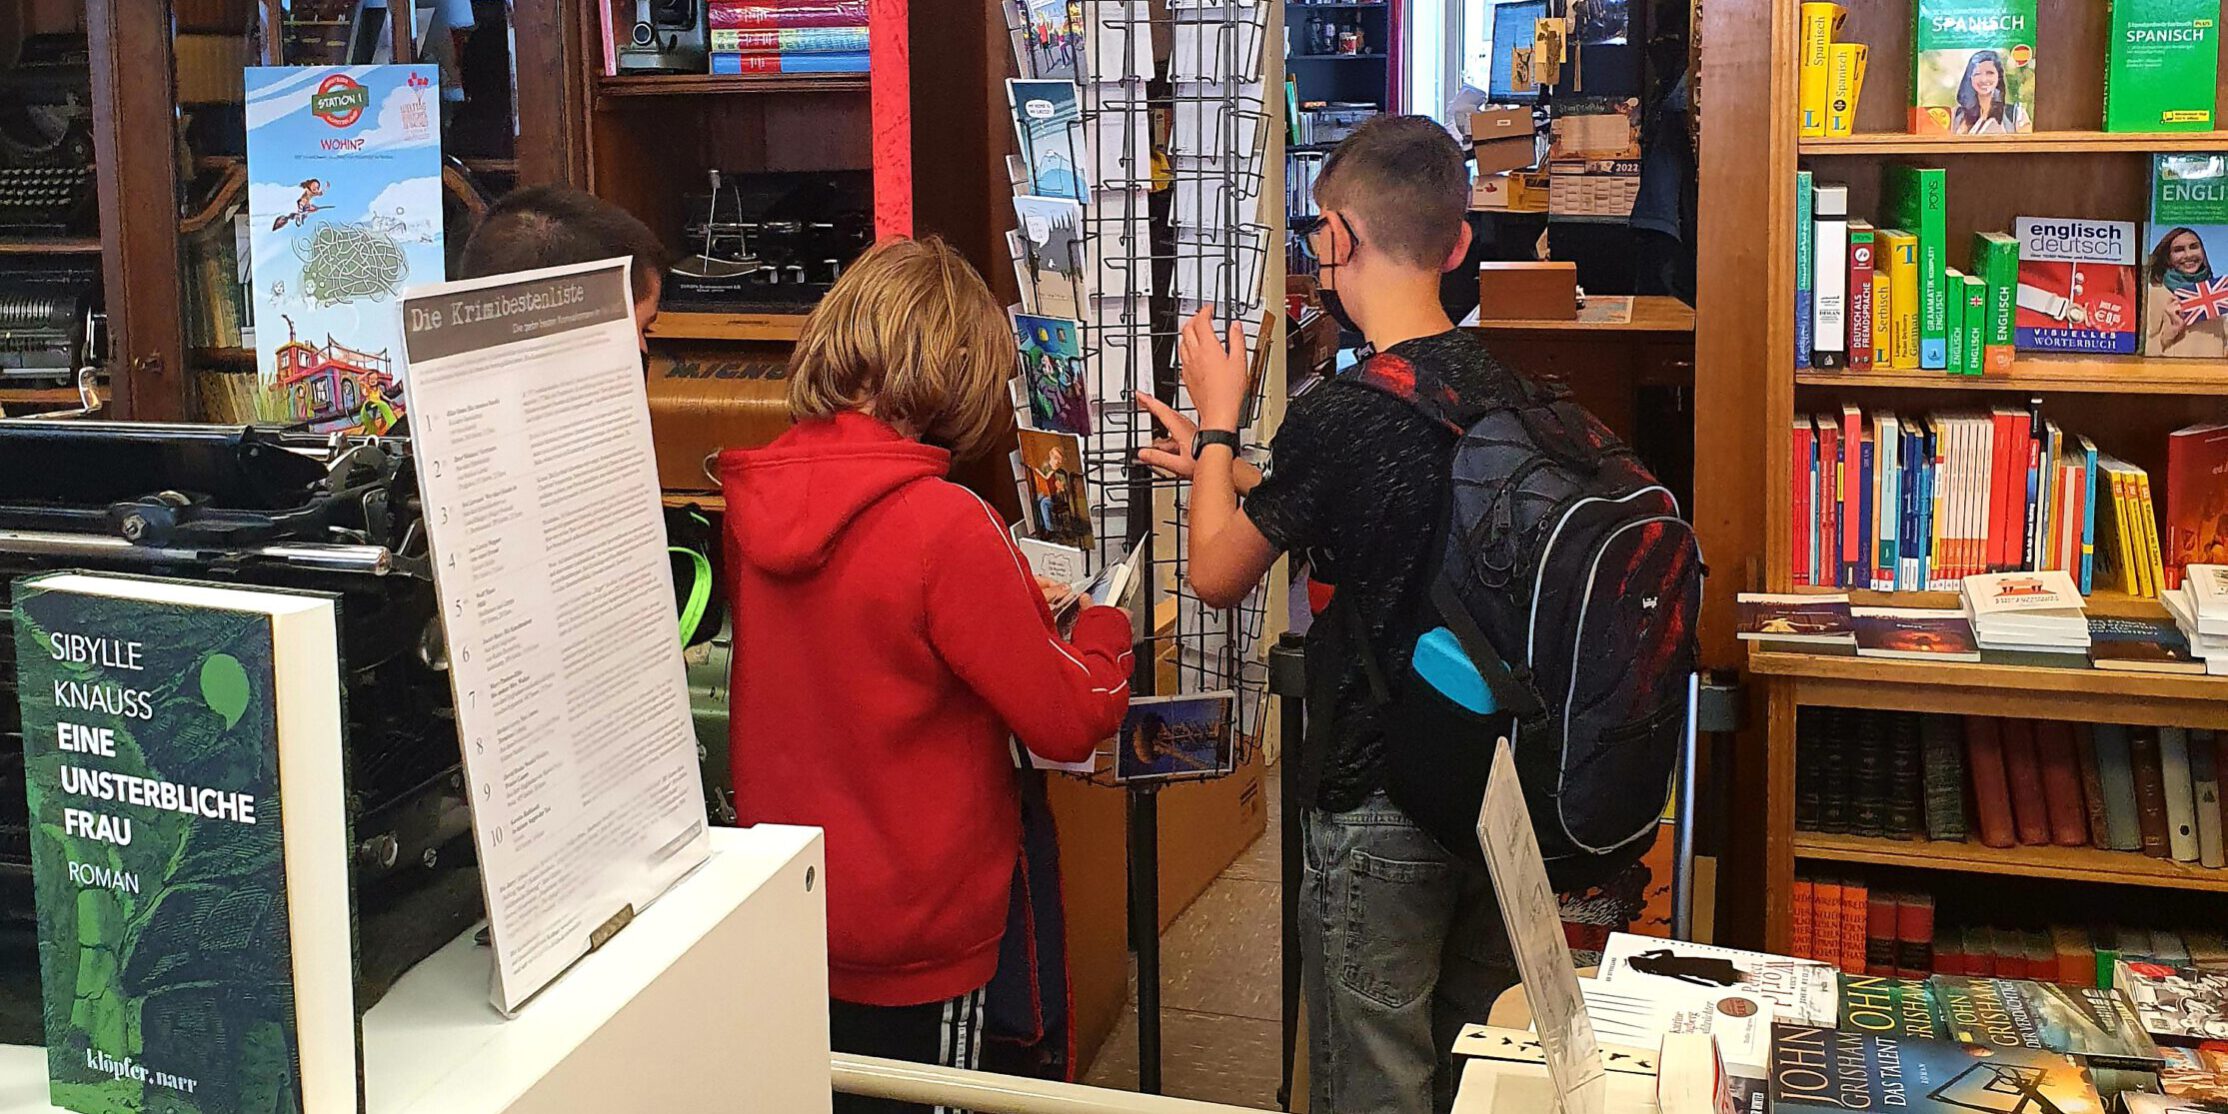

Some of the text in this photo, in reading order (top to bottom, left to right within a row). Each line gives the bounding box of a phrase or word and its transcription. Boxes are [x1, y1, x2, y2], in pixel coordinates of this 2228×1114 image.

[1932, 15, 2025, 32] SPANISCH
[2126, 29, 2204, 42] SPANISCH
[1813, 16, 1826, 67] Spanisch
[1835, 51, 1848, 97] Spanisch
[318, 94, 356, 109] STATION
[320, 138, 365, 151] WOHIN?
[1616, 163, 1639, 172] 2022
[1928, 180, 1940, 210] PONS
[2030, 223, 2121, 240] englisch
[2030, 235, 2122, 255] deutsch
[411, 284, 584, 332] Die Krimibestenliste
[1853, 294, 1862, 348] DEUTSCH ALS
[1862, 282, 1871, 348] FREMDSPRACHE
[1877, 286, 1889, 333] Serbisch
[1927, 279, 1935, 332] GRAMMATIK
[1936, 291, 1944, 331] ENGLISCH
[1997, 286, 2010, 341] ENGLISCH
[1910, 313, 1918, 357] German
[1953, 327, 1961, 366] ENGLISCH
[1970, 327, 1980, 369] ENGLISCH
[2034, 328, 2117, 339] VISUELLES
[2034, 335, 2117, 349] WÖRTERBUCH
[665, 362, 787, 380] MIGNO
[426, 415, 432, 432] 1
[433, 460, 441, 478] 2
[441, 506, 448, 524] 3
[448, 553, 456, 569] 4
[455, 599, 463, 617] 5
[50, 632, 144, 671] SIBYLLE
[462, 645, 470, 663] 6
[54, 680, 153, 720] KNAUSS
[469, 690, 476, 709] 7
[57, 722, 116, 758] EINE
[476, 738, 484, 755] 8
[60, 765, 257, 824] UNSTERBLICHE
[483, 783, 491, 801] 9
[63, 808, 132, 846] FRAU
[491, 826, 503, 848] 10
[68, 861, 139, 895] ROMAN
[1741, 962, 1763, 993] Perfect
[1845, 973, 1896, 1031] OHN
[1947, 994, 1987, 1027] JOHN
[1967, 978, 2020, 1047] GRISHAM
[1998, 980, 2042, 1048] DER VERDÄCHTIGE
[1778, 1023, 1844, 1109] JOHN
[1836, 1032, 1872, 1109] GRISHAM
[1875, 1035, 1907, 1107] DAS TALENT
